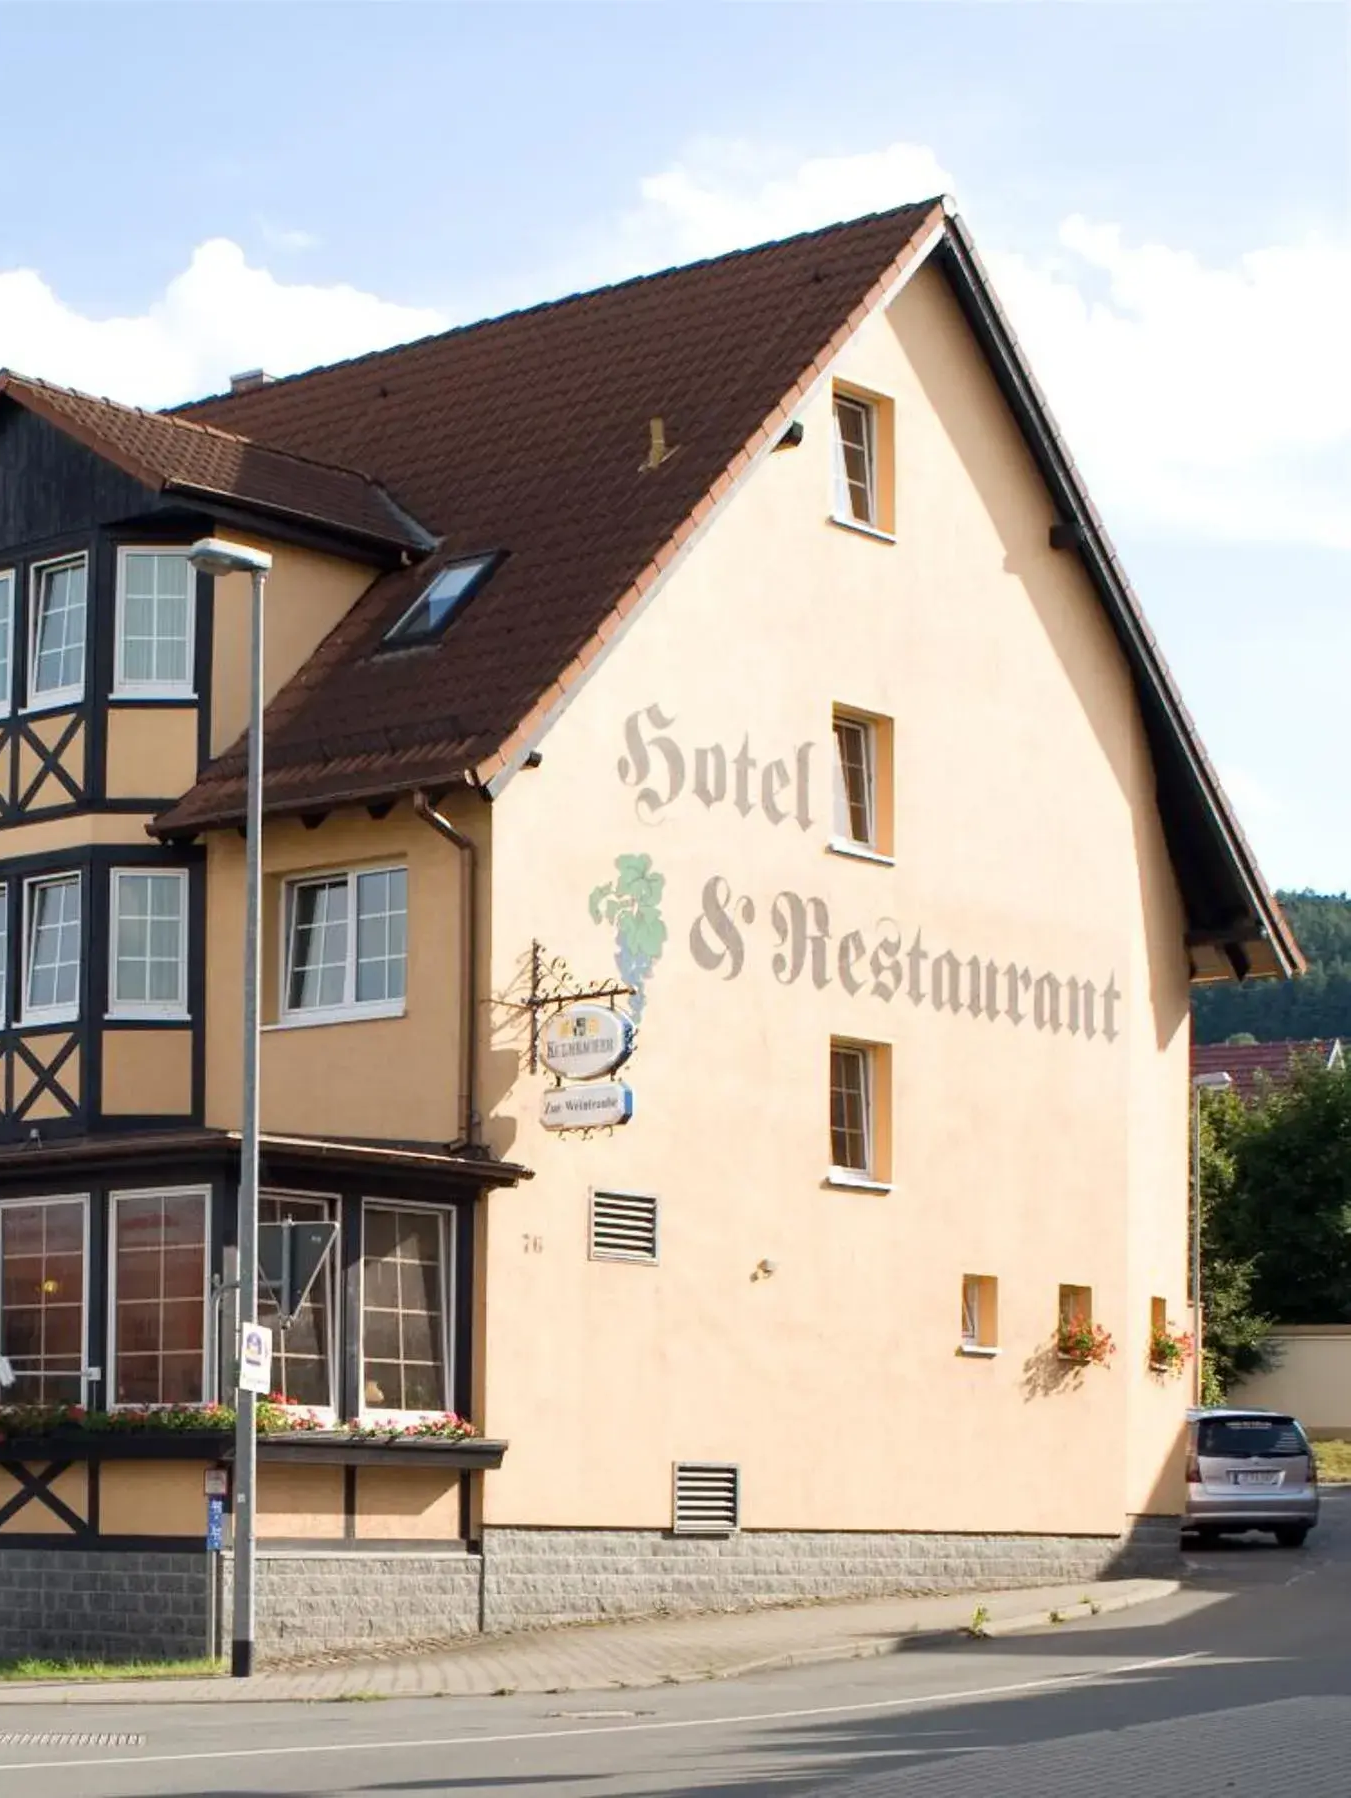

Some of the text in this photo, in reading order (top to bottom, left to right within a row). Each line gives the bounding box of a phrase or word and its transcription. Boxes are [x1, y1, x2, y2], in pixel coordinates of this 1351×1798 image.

[617, 702, 817, 832] Hotel
[689, 875, 1123, 1044] & Restaurant
[565, 1096, 619, 1112] Weintraube
[521, 1232, 543, 1254] 76
